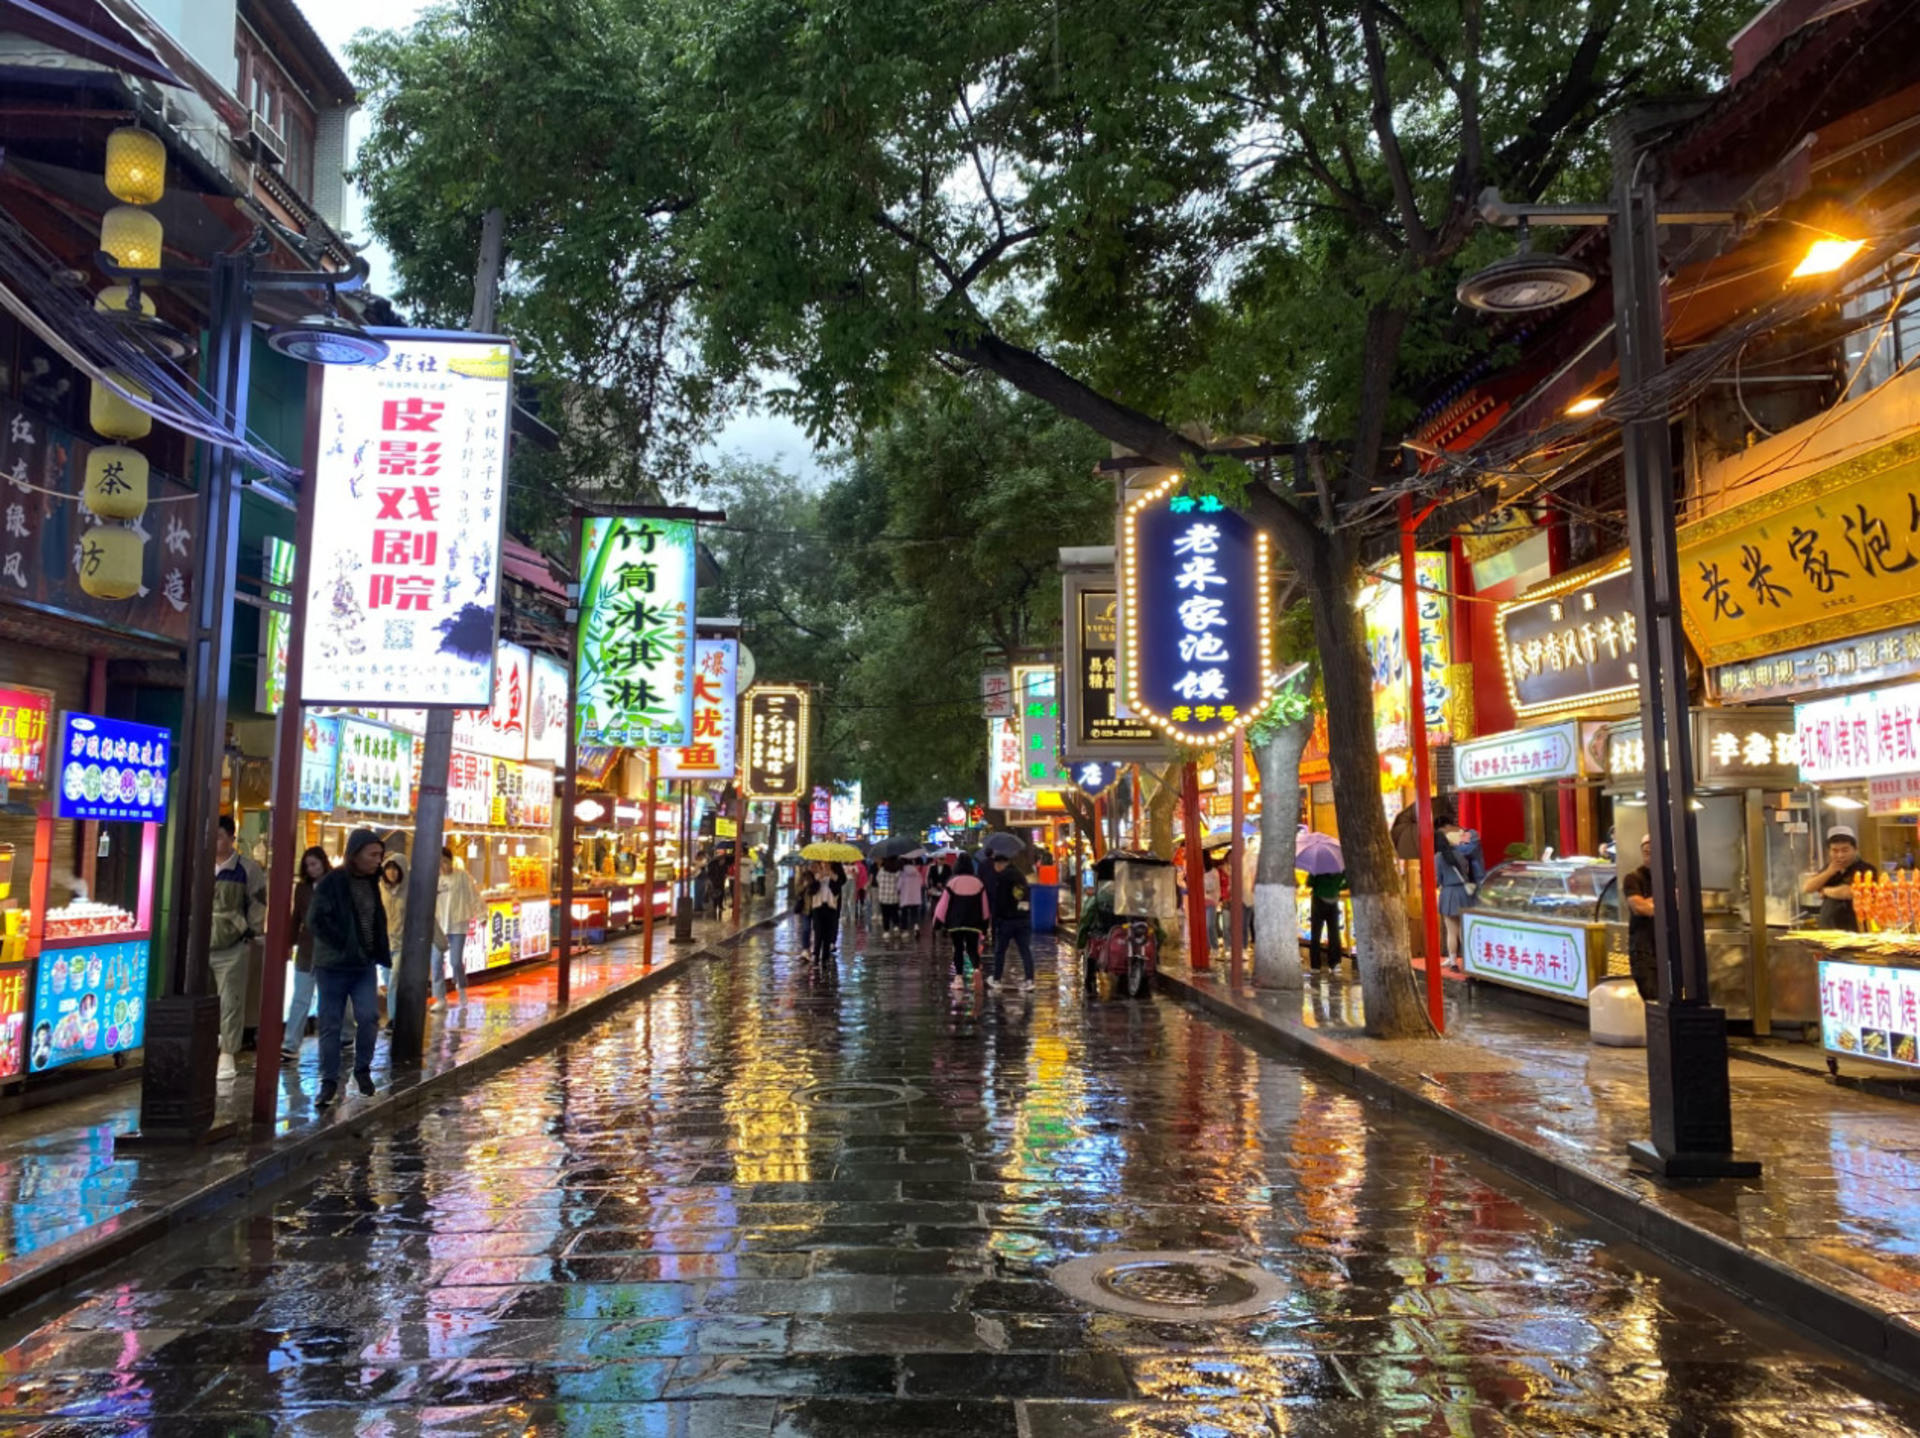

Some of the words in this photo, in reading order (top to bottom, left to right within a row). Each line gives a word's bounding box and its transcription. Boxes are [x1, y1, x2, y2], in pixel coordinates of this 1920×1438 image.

[95, 461, 132, 495] 茶
[368, 397, 446, 611] 皮影戏剧院
[603, 523, 667, 711] 竹筒冰淇淋
[1698, 492, 1920, 621] 老米家泡
[1876, 705, 1920, 765] 烤鱿
